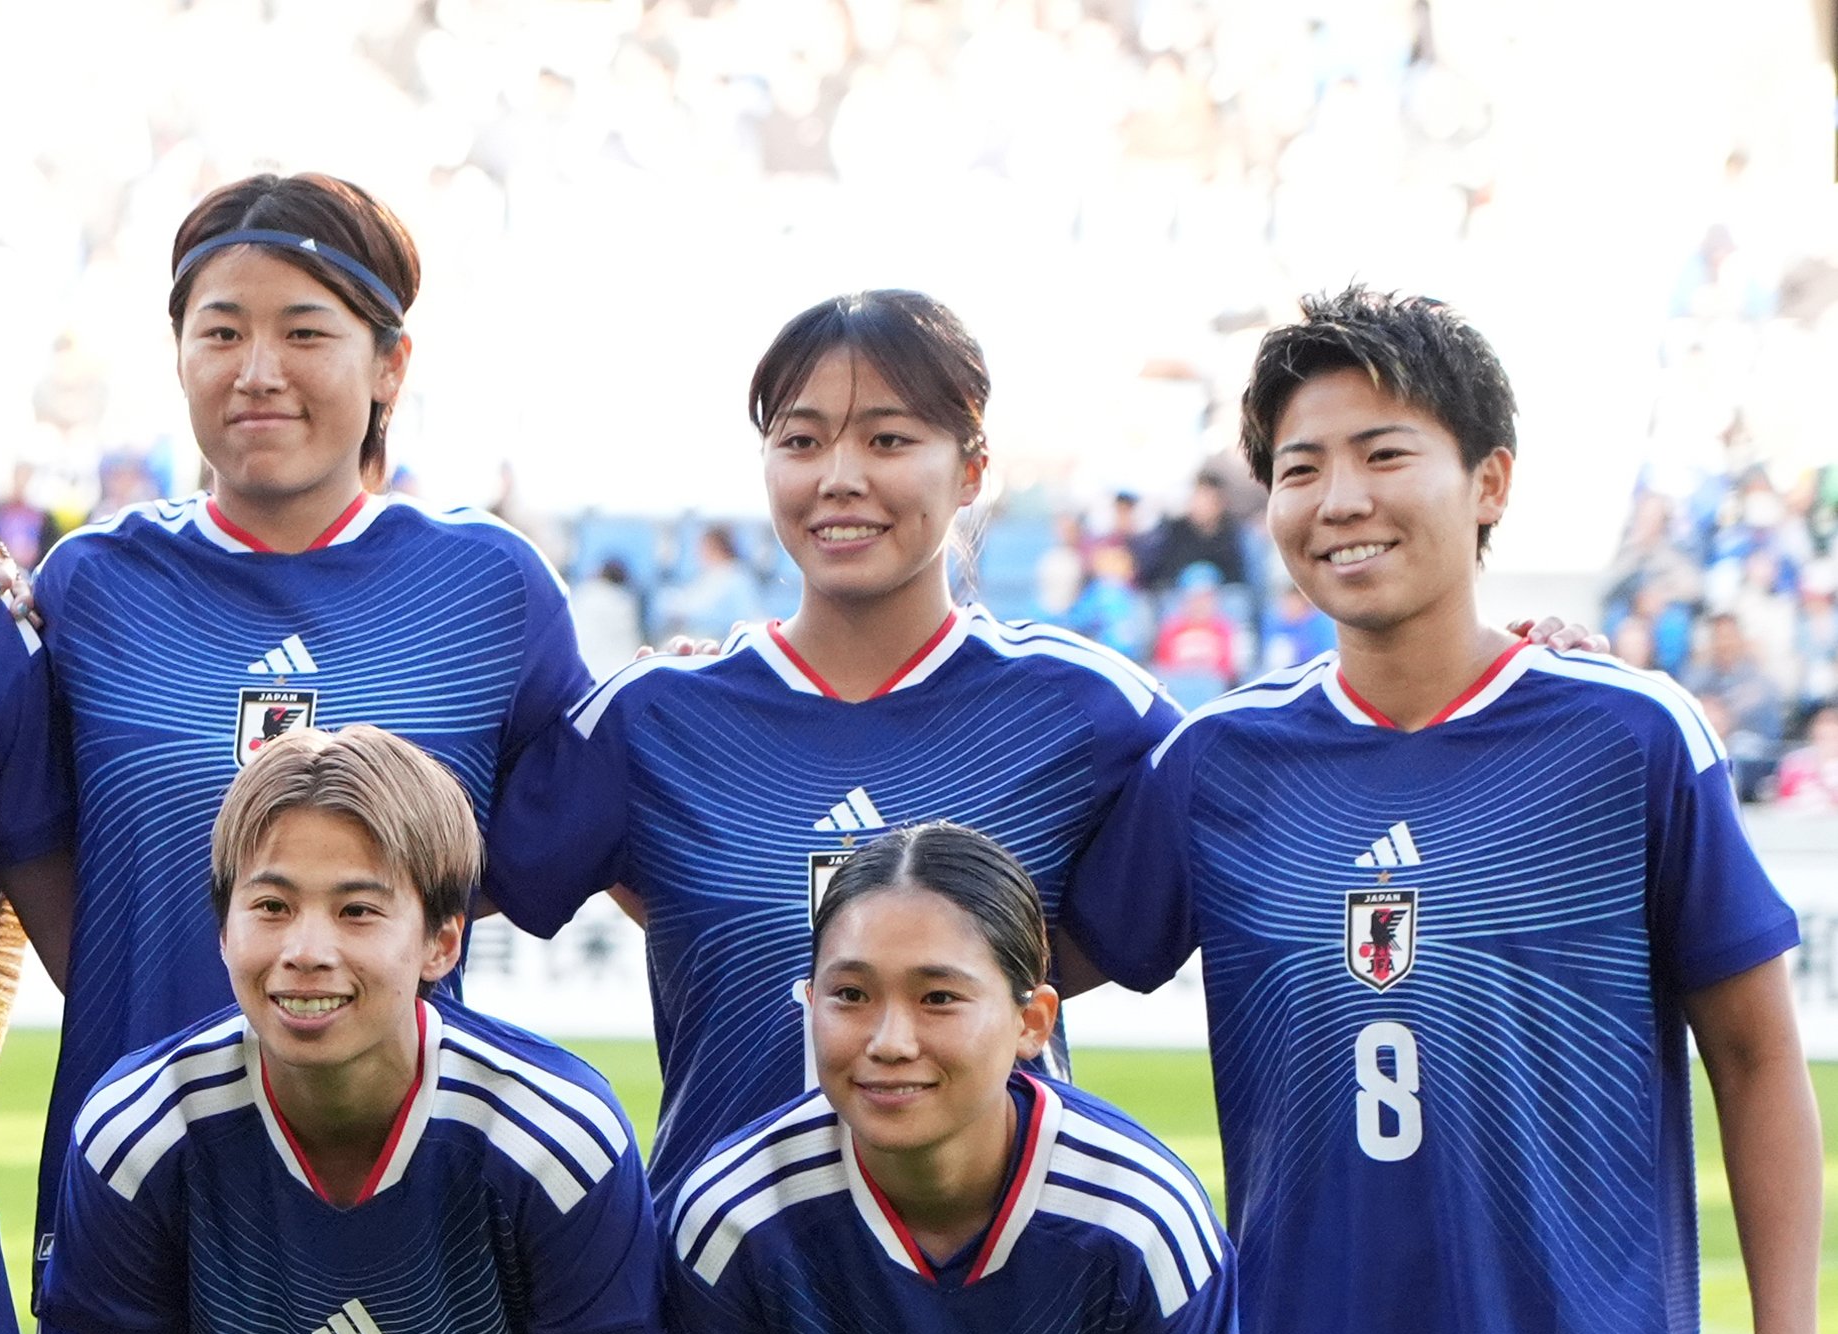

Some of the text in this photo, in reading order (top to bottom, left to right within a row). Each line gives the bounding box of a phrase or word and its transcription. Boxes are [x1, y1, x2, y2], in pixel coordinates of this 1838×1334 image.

[259, 692, 298, 702] JAPAN
[1363, 892, 1401, 904] JAPAN
[1354, 1021, 1422, 1161] 8
